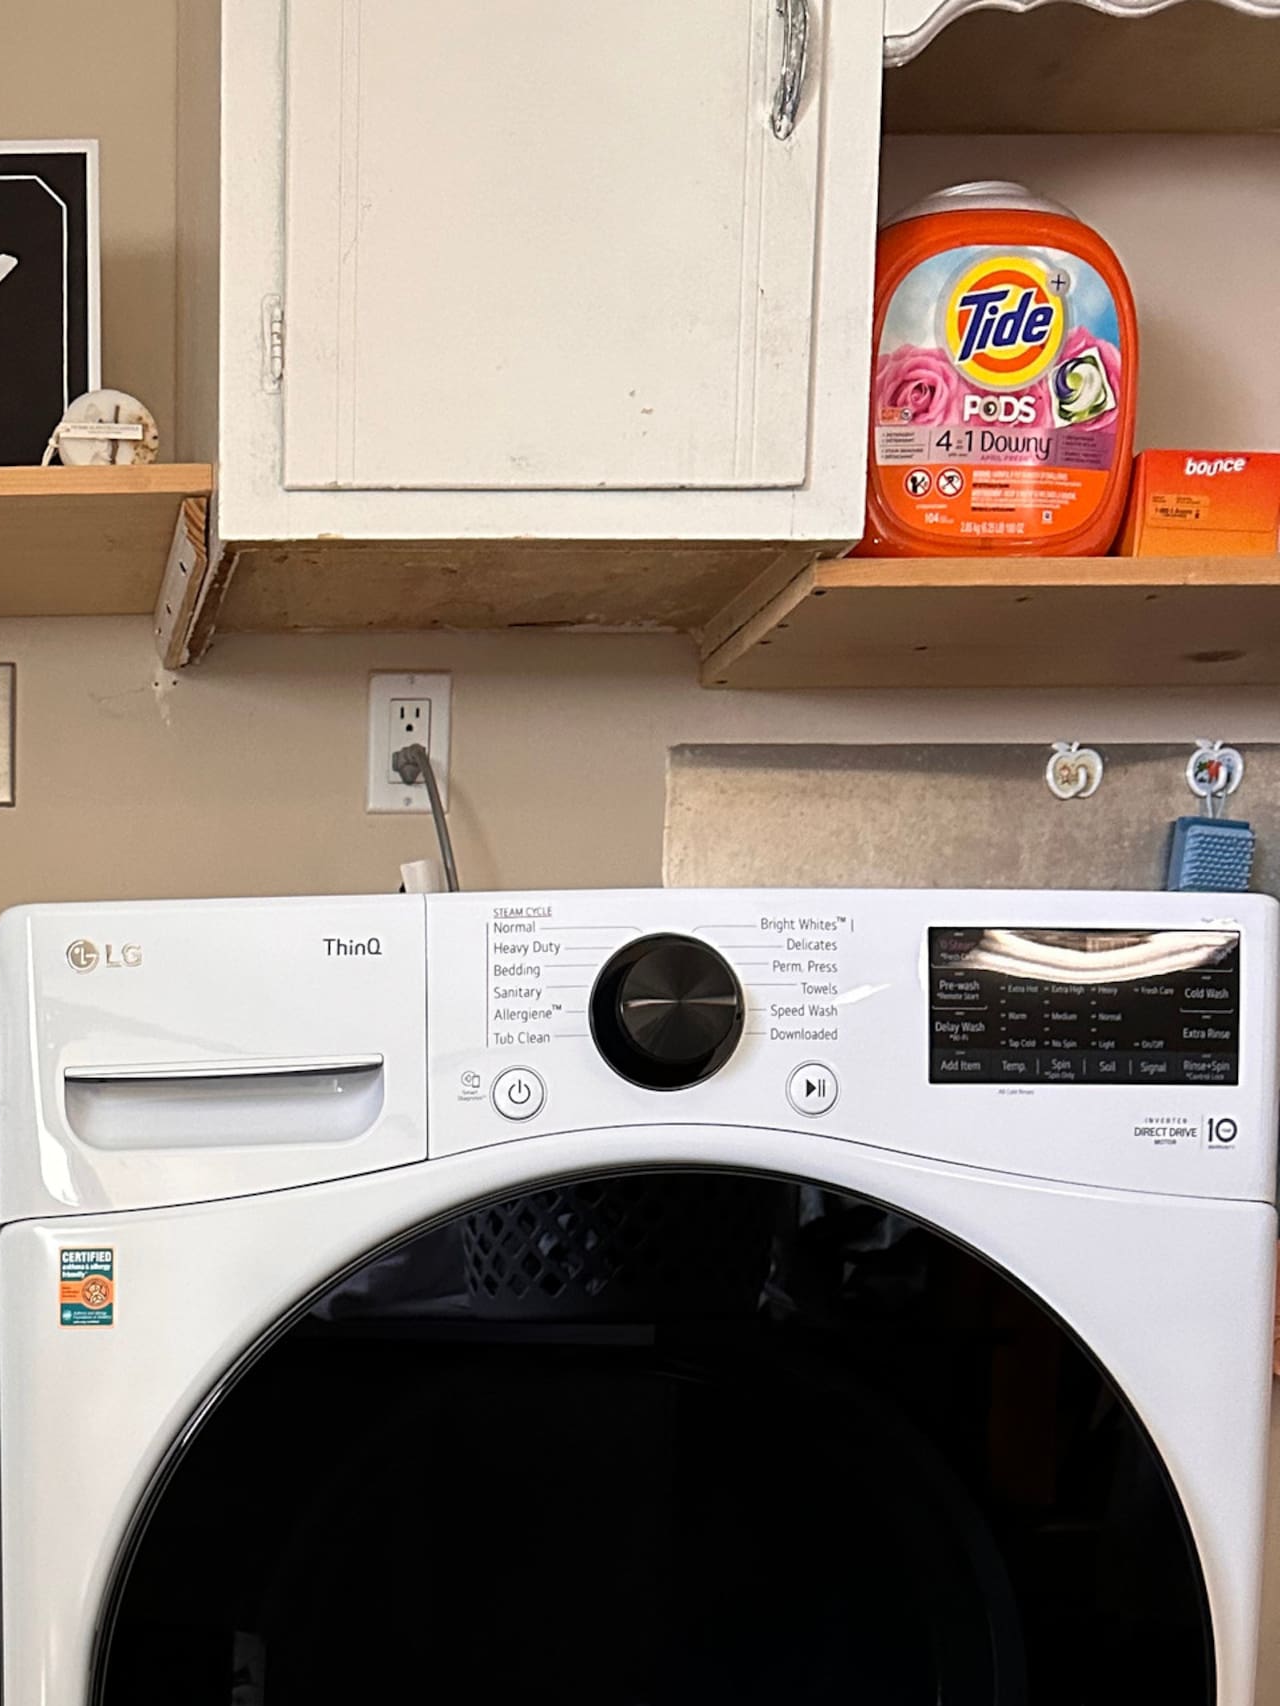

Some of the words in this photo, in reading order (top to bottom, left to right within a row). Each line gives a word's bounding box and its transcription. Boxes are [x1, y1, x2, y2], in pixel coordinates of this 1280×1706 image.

[959, 289, 1054, 363] Tide
[963, 395, 1037, 424] PODS
[936, 430, 952, 452] 4
[965, 430, 974, 452] 1
[980, 430, 1053, 461] Downy
[1185, 457, 1246, 476] bounce
[493, 908, 523, 918] STEAM
[526, 907, 553, 917] CYCLE
[493, 920, 536, 933] Normal
[760, 918, 796, 932] Bright
[323, 938, 382, 956] ThinQ
[493, 942, 531, 956] Heavy
[533, 940, 561, 956] Duty
[786, 938, 838, 952] Delicates
[105, 943, 143, 968] LG
[493, 963, 541, 978] Bedding
[772, 960, 804, 974] Perm.
[807, 960, 838, 973] Press
[801, 982, 838, 996] Towels
[939, 979, 980, 991] Pre-wash
[493, 986, 542, 1000] Sanitary
[1184, 988, 1204, 999] Cold
[1206, 988, 1229, 999] Wash
[770, 1004, 805, 1019] Speed
[808, 1004, 838, 1018] Wash
[935, 1021, 959, 1033] Delay
[961, 1021, 985, 1032] Wash
[1183, 1027, 1206, 1039] Extra
[1207, 1027, 1231, 1039] Rinse
[493, 1032, 515, 1044] Tub
[517, 1031, 551, 1044] Clean
[770, 1028, 838, 1041] Downloaded
[940, 1060, 959, 1071] Add
[960, 1060, 981, 1071] Item
[1051, 1058, 1071, 1070] Spin
[1099, 1061, 1116, 1072] Soil
[1140, 1061, 1167, 1075] Signal
[1134, 1127, 1168, 1137] DIRECT
[1169, 1127, 1198, 1138] DRIVE
[1208, 1118, 1237, 1142] 10
[62, 1251, 112, 1263] CERTIFIED
